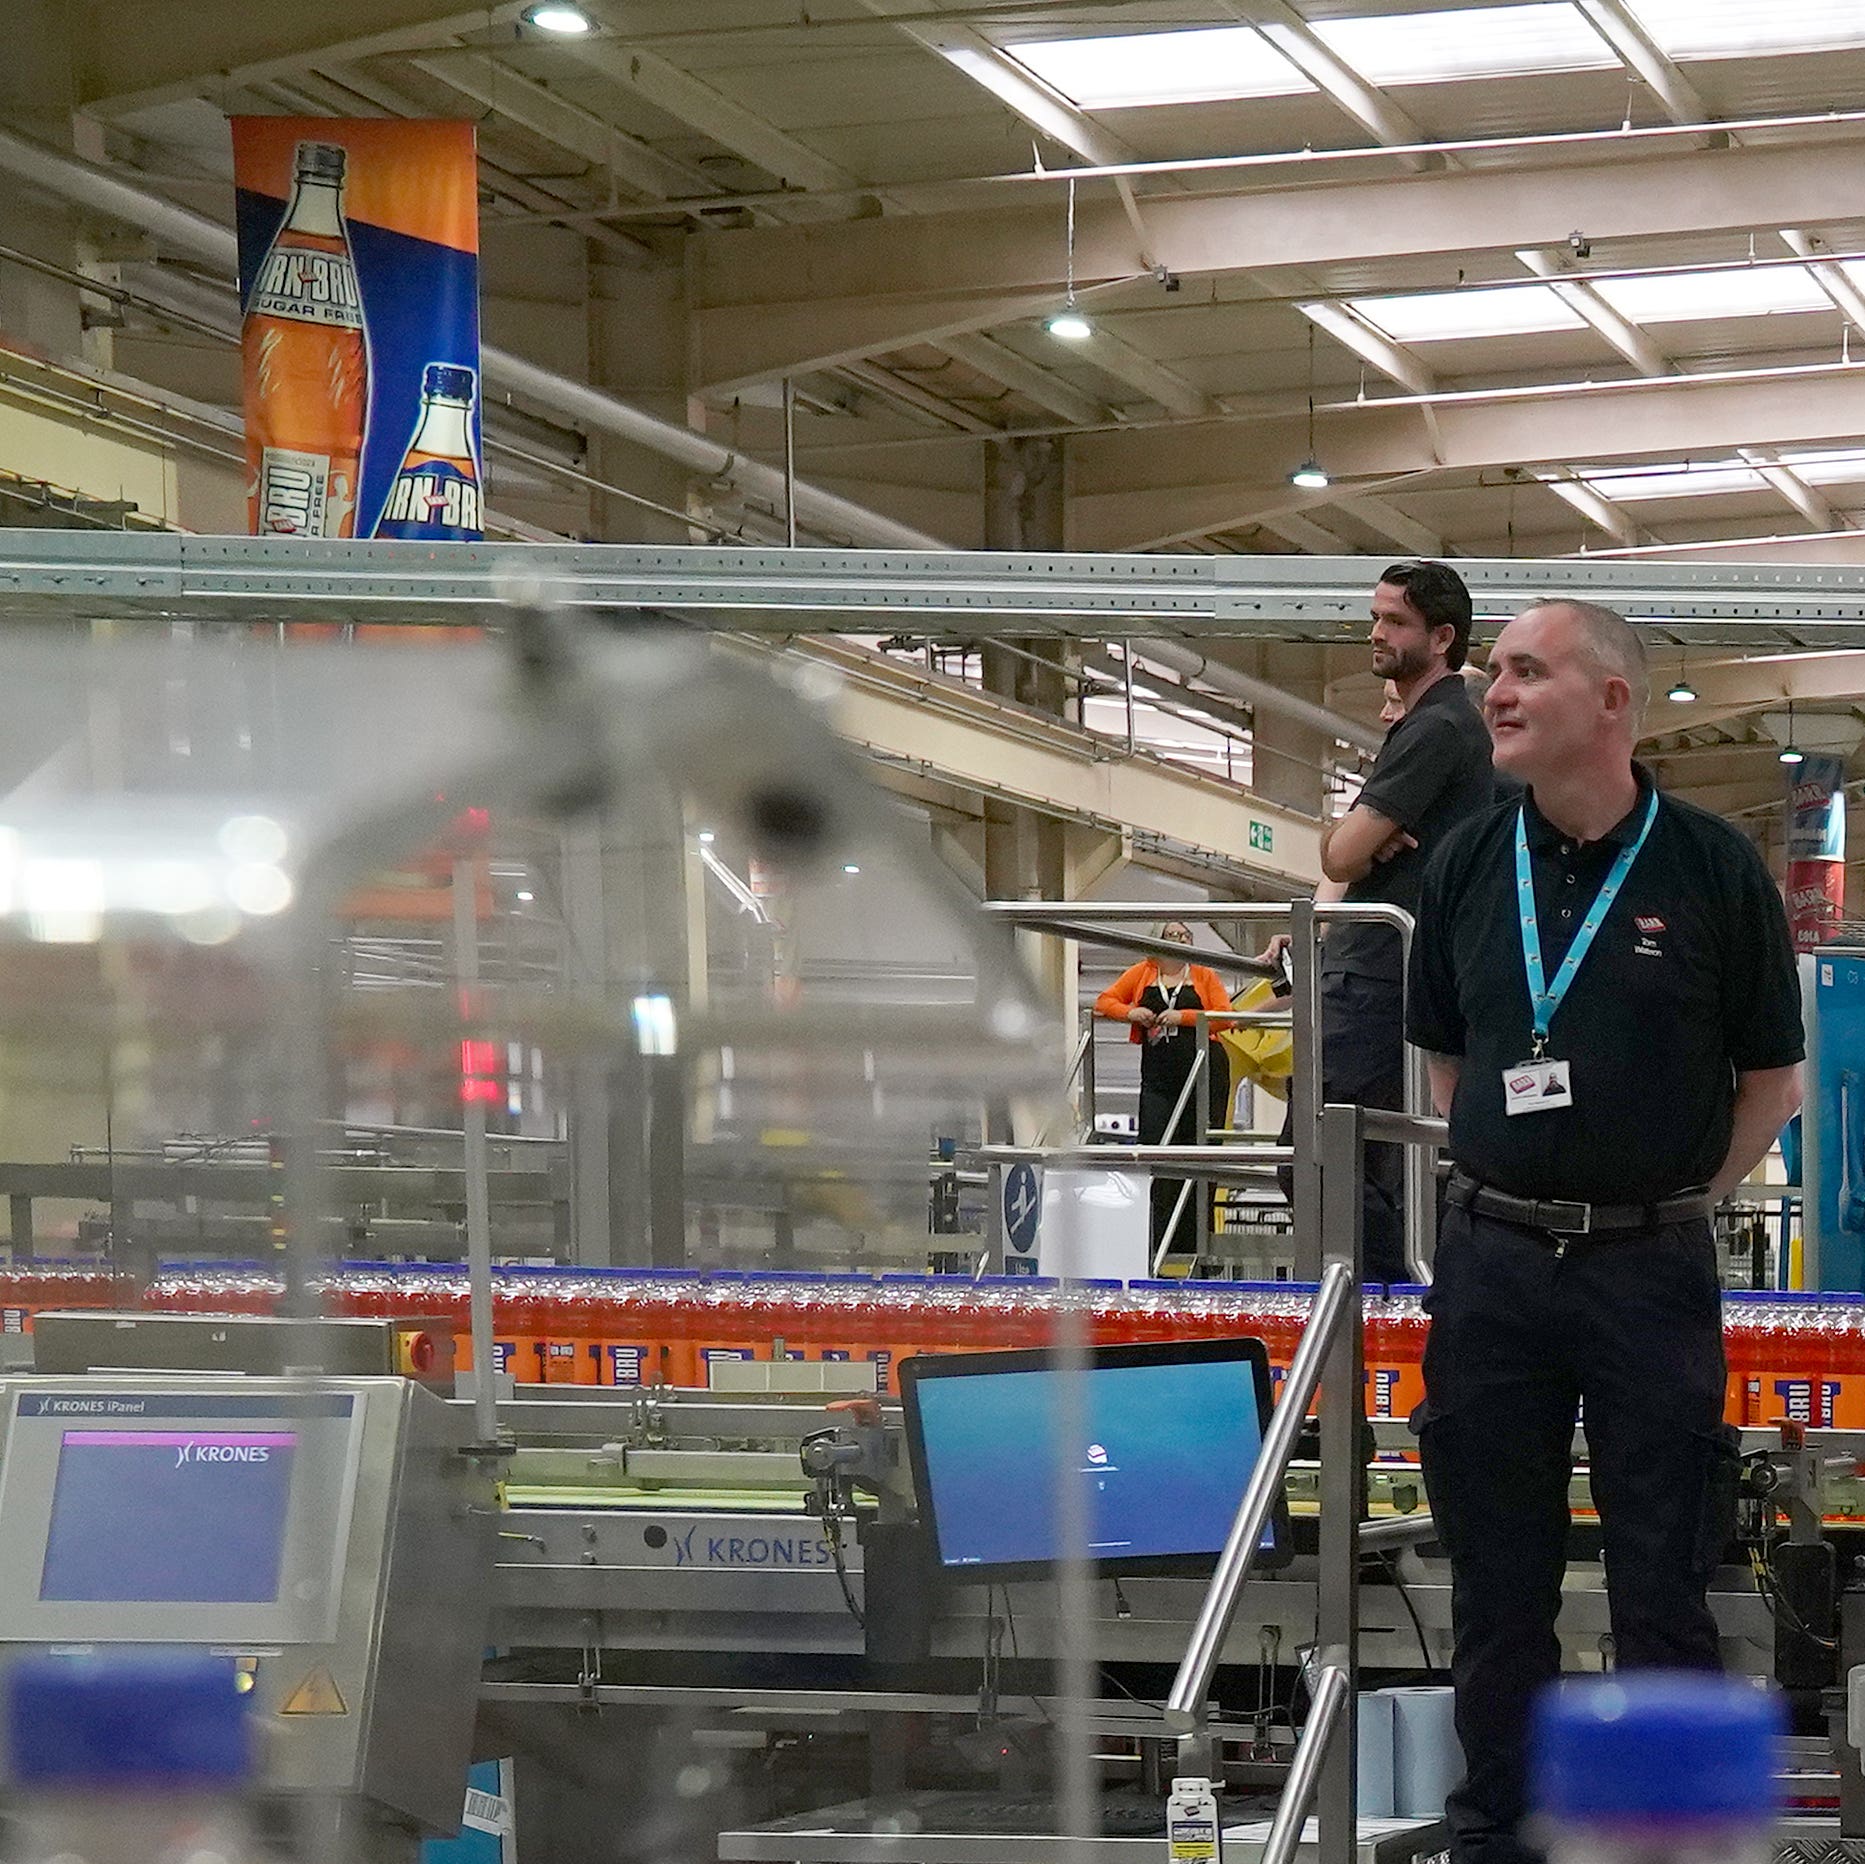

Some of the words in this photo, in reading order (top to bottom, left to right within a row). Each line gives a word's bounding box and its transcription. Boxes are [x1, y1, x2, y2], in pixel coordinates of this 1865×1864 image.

[266, 466, 312, 529] BRU
[615, 1347, 639, 1378] BRU
[1375, 1371, 1390, 1405] BRU
[1788, 1383, 1811, 1423] BRU
[53, 1400, 104, 1413] KRONES
[107, 1400, 145, 1413] iPanel
[196, 1446, 270, 1462] KRONES
[709, 1536, 831, 1565] KRONES
